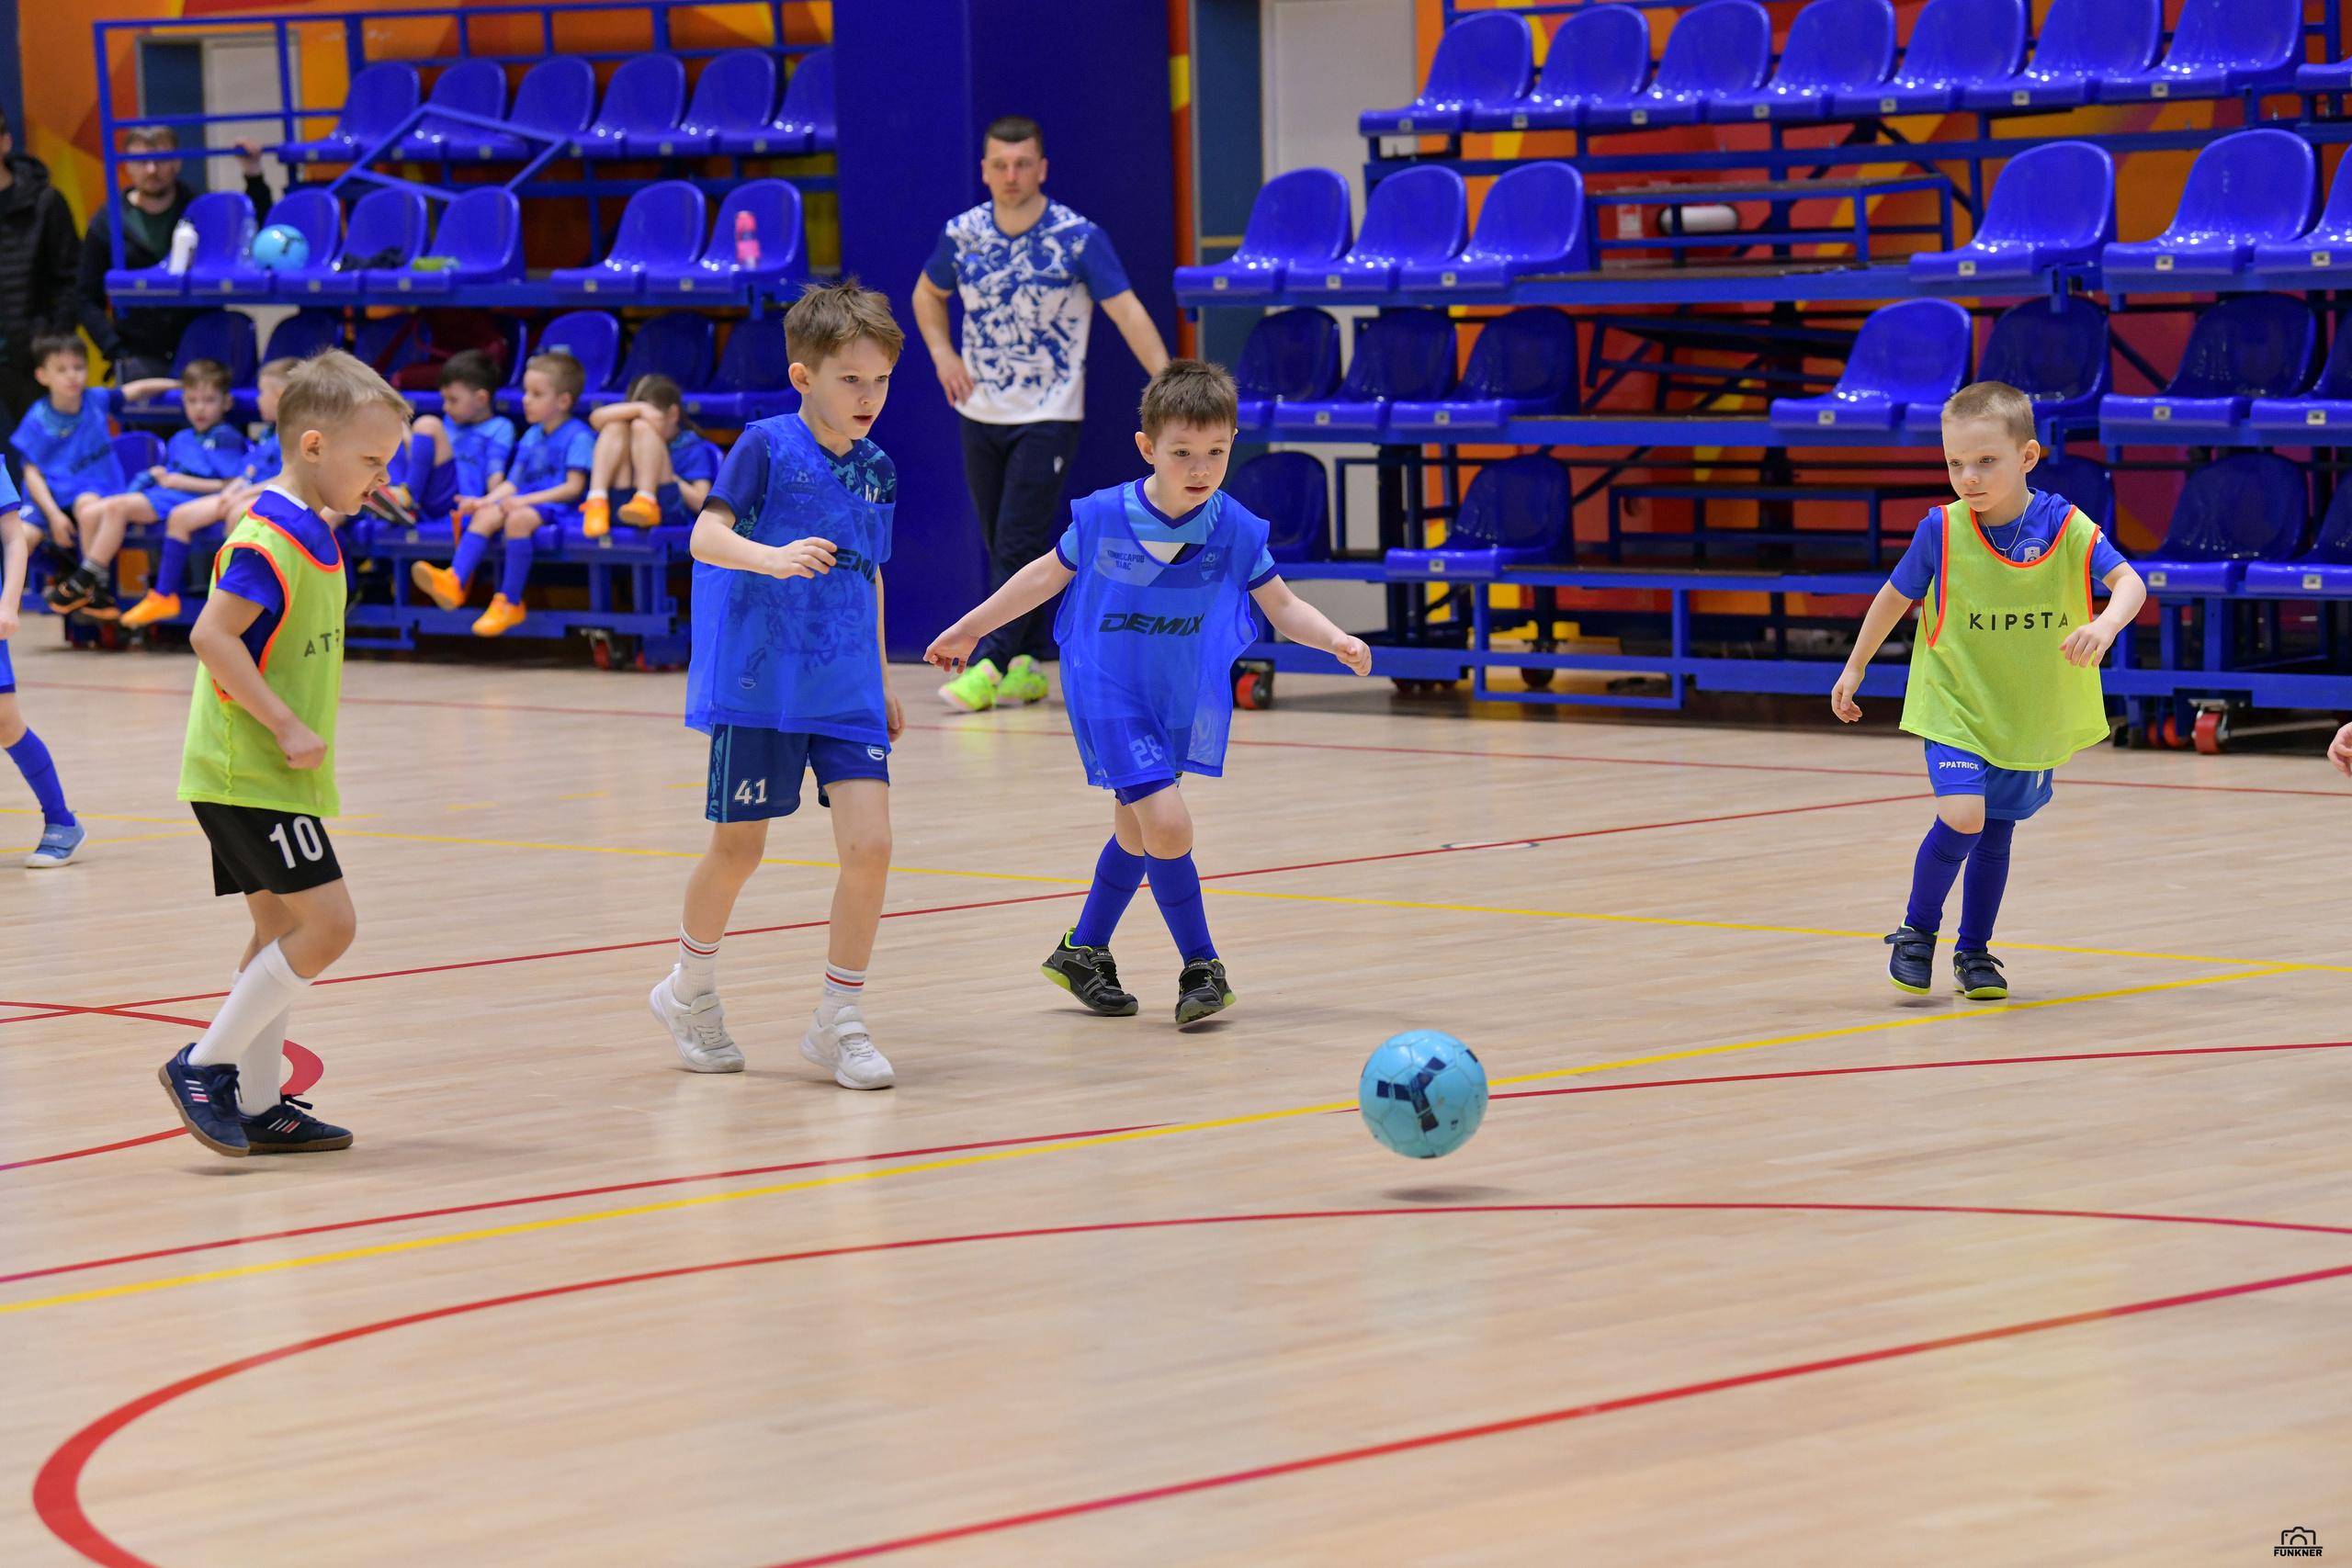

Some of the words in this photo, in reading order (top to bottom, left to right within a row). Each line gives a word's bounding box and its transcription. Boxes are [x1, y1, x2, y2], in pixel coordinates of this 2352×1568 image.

[1099, 613, 1205, 636] DEMIX
[1969, 612, 2068, 631] KIPSTA
[1946, 761, 1979, 771] PATRICK
[734, 778, 767, 805] 41
[268, 816, 323, 869] 10
